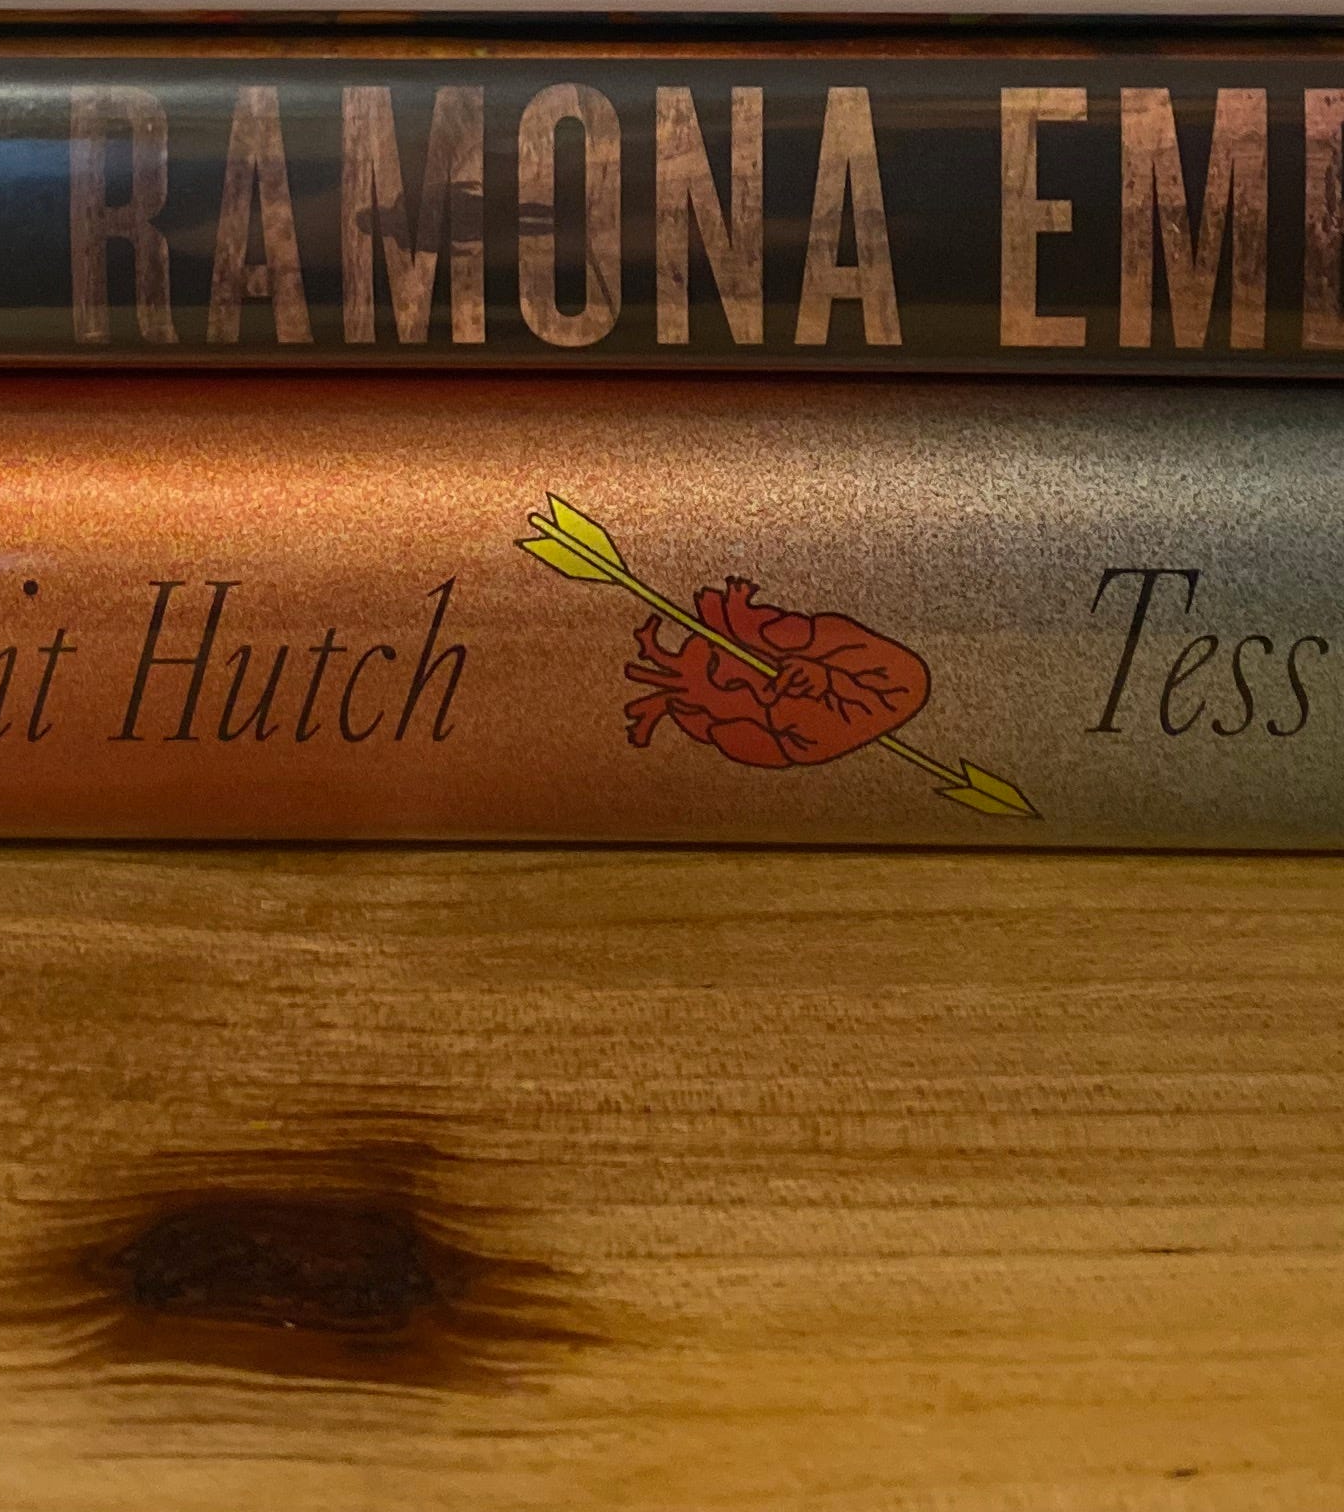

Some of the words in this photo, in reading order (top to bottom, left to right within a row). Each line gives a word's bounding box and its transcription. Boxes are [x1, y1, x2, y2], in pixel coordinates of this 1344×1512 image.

[67, 82, 904, 348] RAMONA
[106, 575, 470, 745] Hutch
[1084, 567, 1331, 738] Tess
